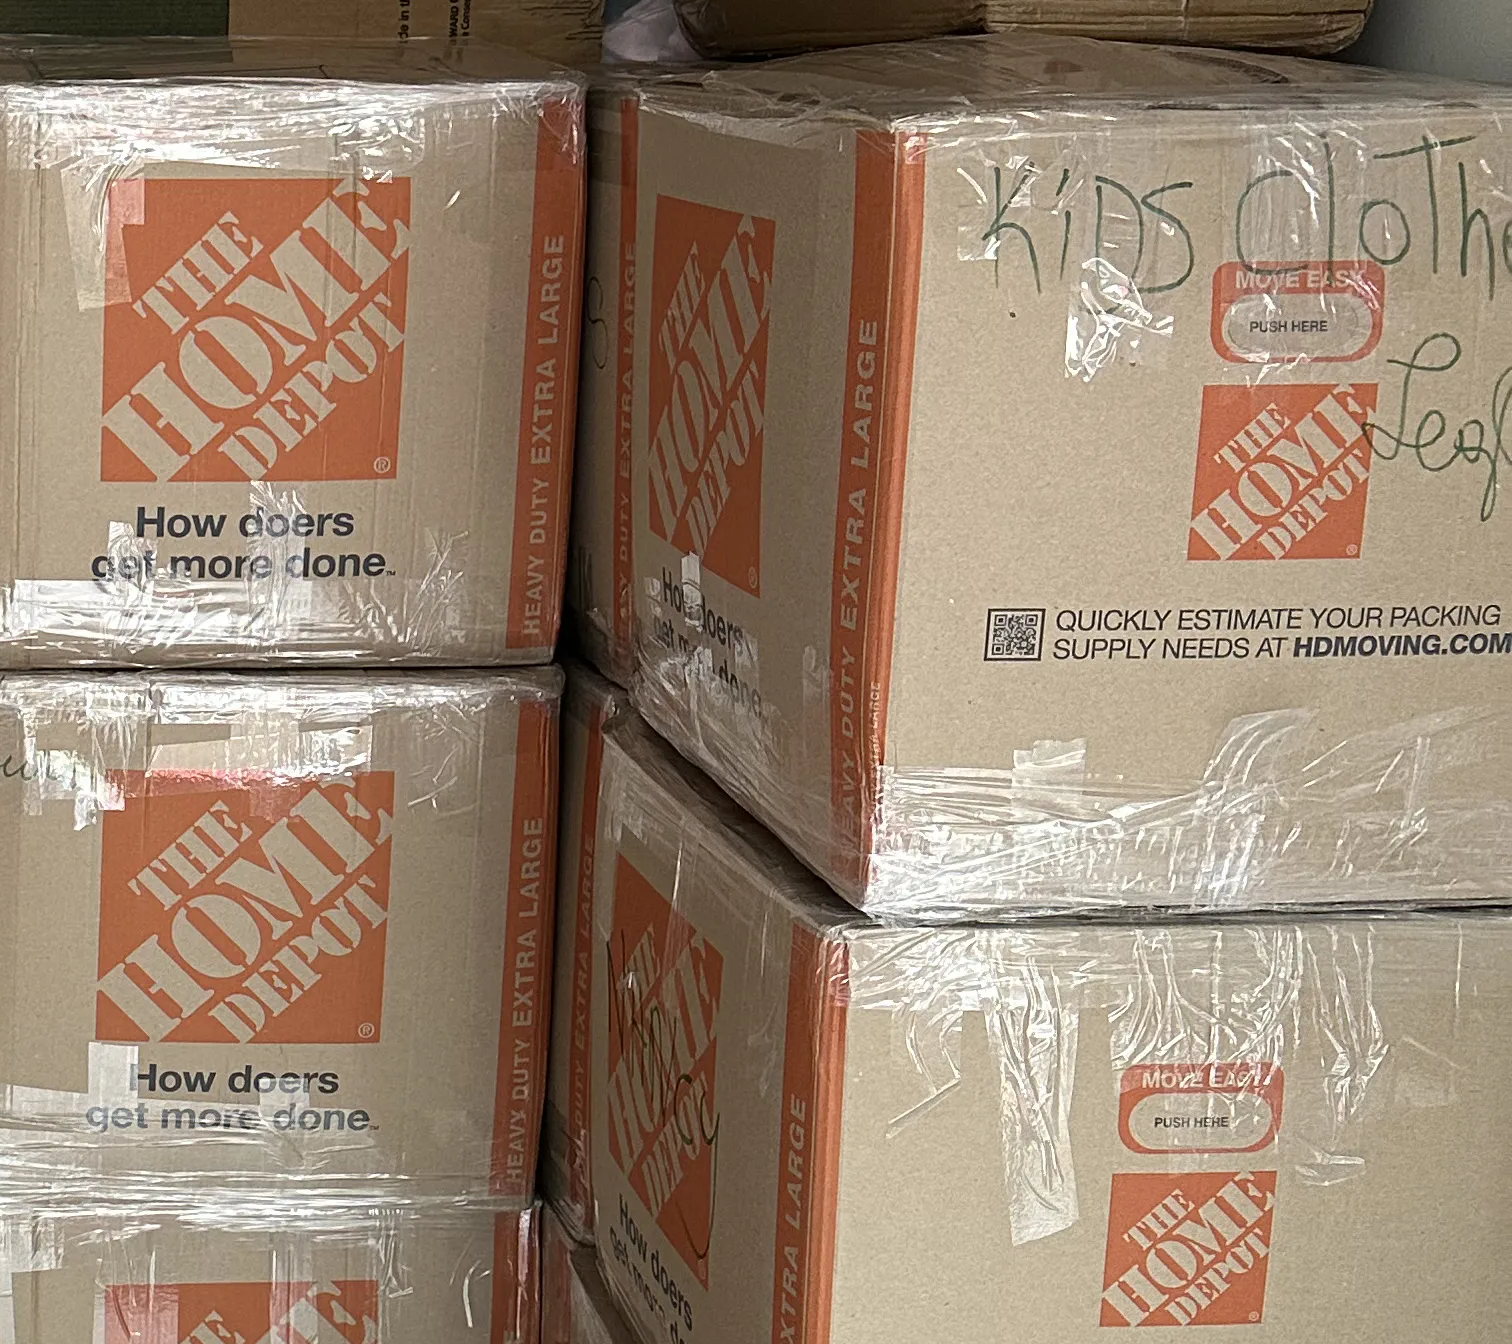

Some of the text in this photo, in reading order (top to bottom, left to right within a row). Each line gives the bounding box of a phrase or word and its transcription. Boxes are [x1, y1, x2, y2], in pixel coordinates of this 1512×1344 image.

[101, 177, 407, 481] HOME
[133, 211, 263, 337] THE
[1236, 269, 1299, 289] MOVE
[1249, 320, 1328, 334] PUSH HERE
[217, 295, 402, 480] DEPOT
[522, 234, 564, 634] HEAVY DUTY EXTRA LARGE
[1214, 403, 1291, 475] THE
[136, 507, 354, 538] How doers
[840, 320, 878, 631] EXTRA LARGE
[1191, 383, 1375, 560] HOME
[1256, 451, 1369, 559] DEPOT
[1053, 632, 1512, 661] SUPPLY NEEDS AT HDMOVING.COM
[1055, 604, 1502, 632] QUICKLY ESTIMATE YOUR PACKING
[97, 771, 391, 1042] HOME
[129, 800, 253, 912] THE
[207, 877, 386, 1043] DEPOT
[1154, 1115, 1228, 1129] PUSH HERE
[1102, 1171, 1273, 1326] HOME
[1123, 1188, 1195, 1252] THE
[1164, 1231, 1268, 1325] DEPOT
